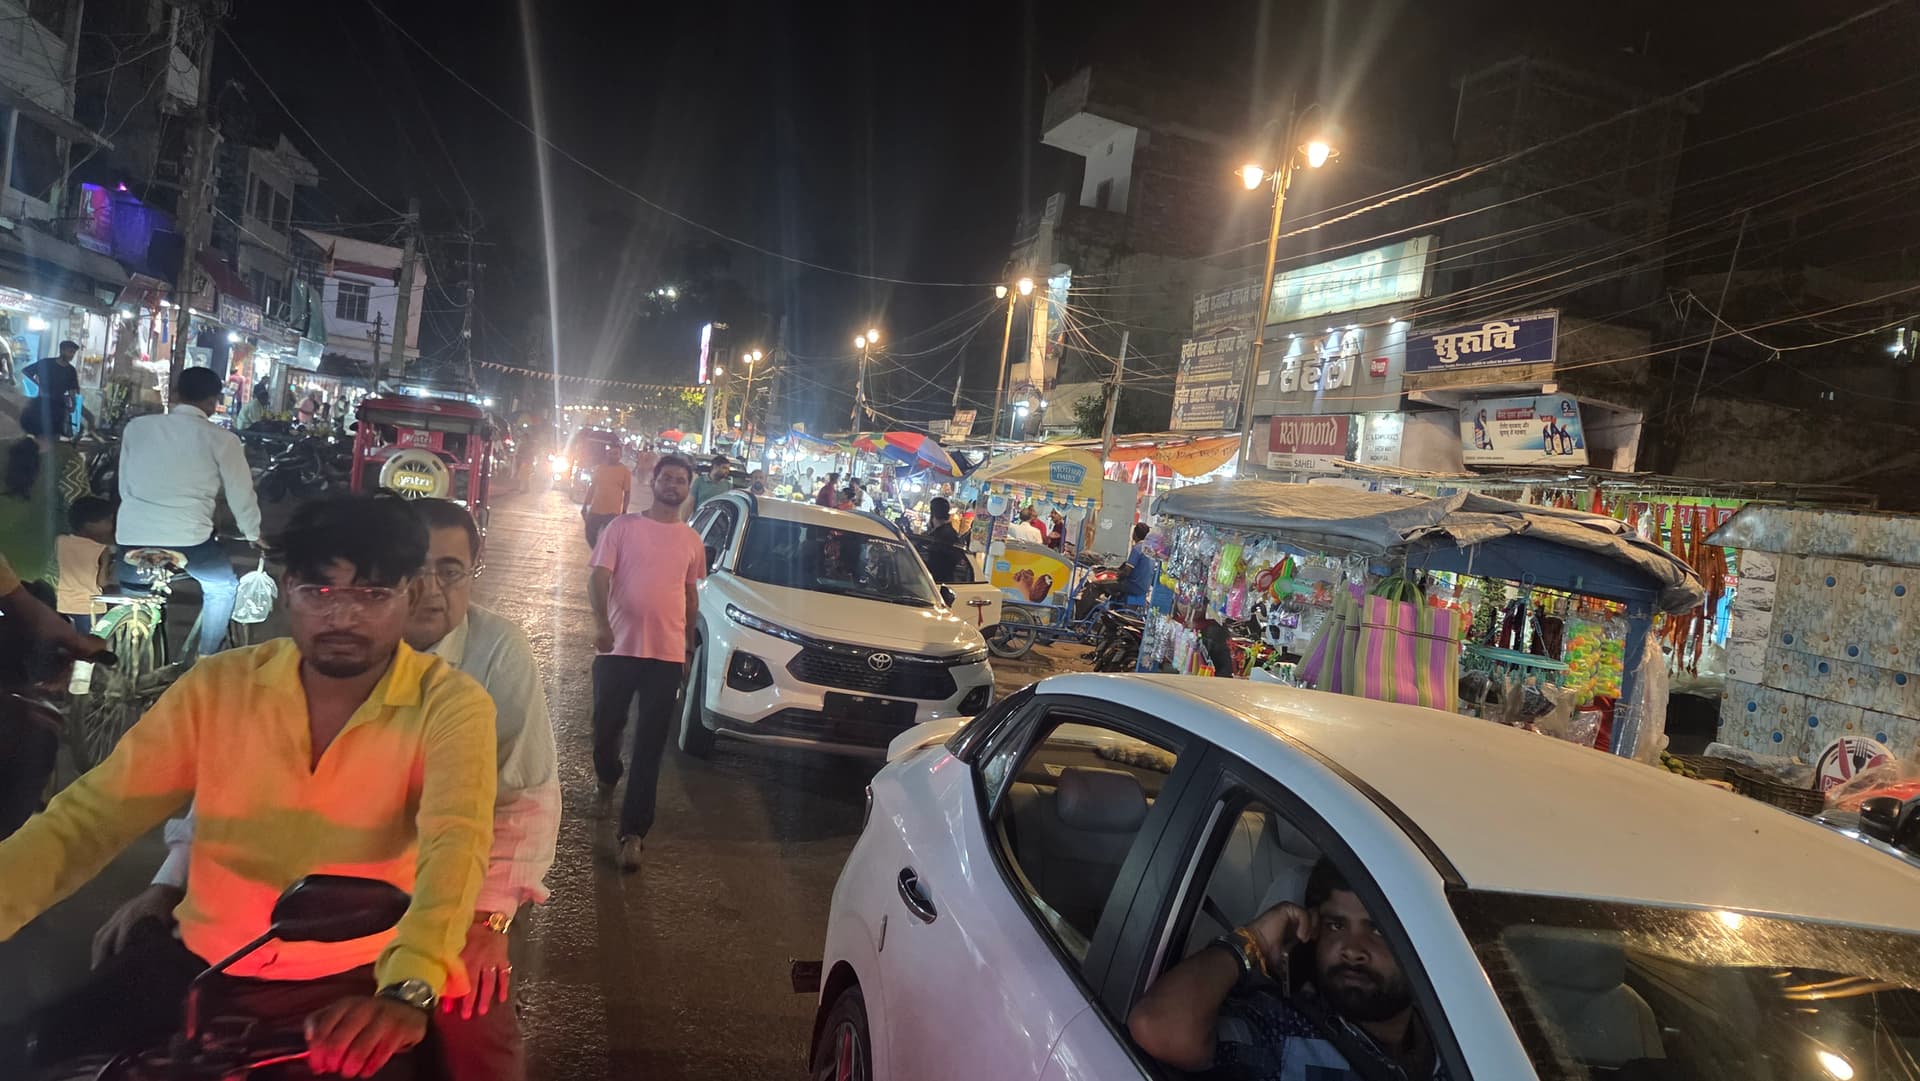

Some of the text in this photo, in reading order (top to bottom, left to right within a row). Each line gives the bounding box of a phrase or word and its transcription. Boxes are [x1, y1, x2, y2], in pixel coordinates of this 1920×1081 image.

[1280, 329, 1363, 392] सहेली
[1279, 416, 1338, 452] Raymond
[1294, 459, 1316, 468] SAHELI
[1052, 464, 1082, 476] MOTHER
[1056, 473, 1076, 481] DAIRY
